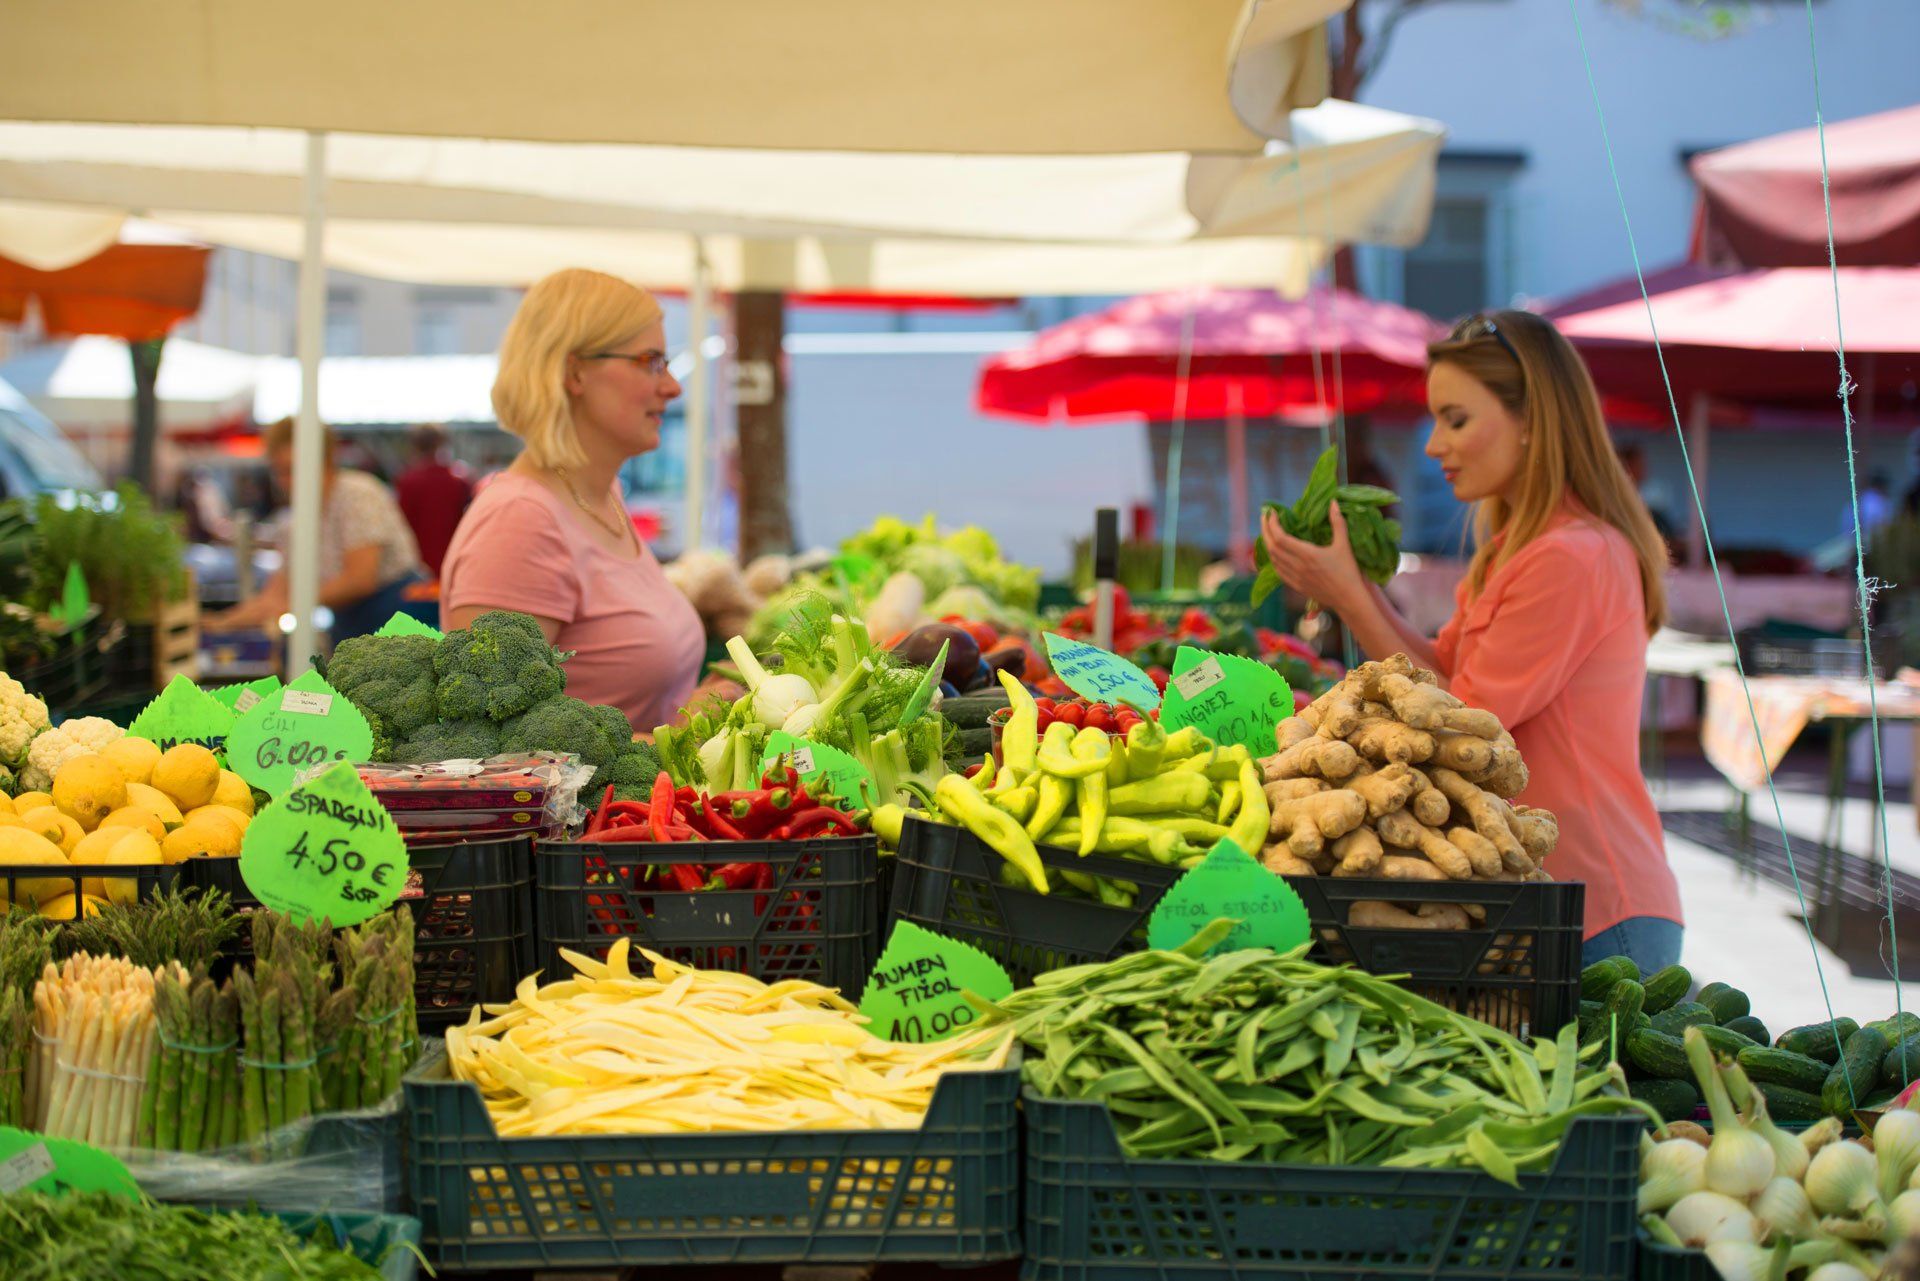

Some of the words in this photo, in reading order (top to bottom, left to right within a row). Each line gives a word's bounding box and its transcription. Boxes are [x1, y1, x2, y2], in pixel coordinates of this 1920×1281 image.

[1175, 690, 1234, 729] INGVER
[1269, 691, 1285, 708] €
[286, 830, 366, 876] 4.50
[371, 863, 394, 886] €
[894, 977, 961, 1008] FIŽOL
